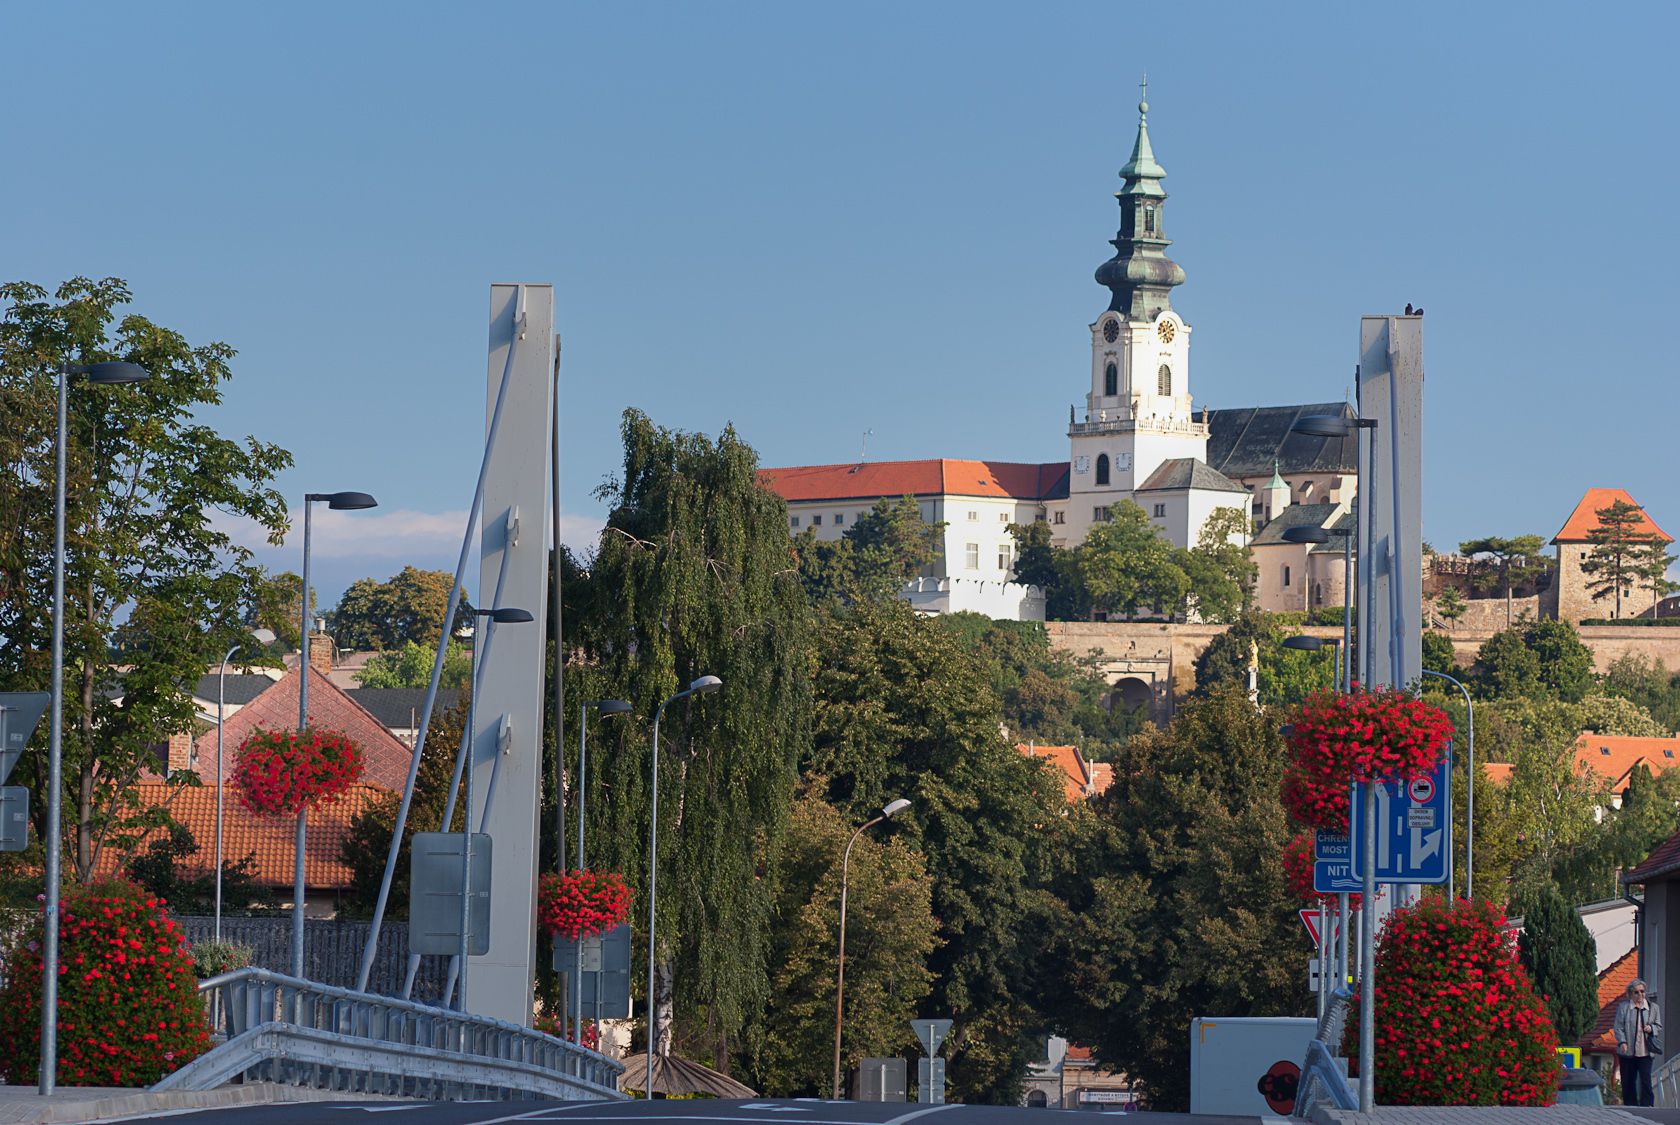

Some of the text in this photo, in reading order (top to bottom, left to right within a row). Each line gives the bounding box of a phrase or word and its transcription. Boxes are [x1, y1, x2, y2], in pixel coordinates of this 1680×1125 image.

[1317, 834, 1348, 843] CHREN
[1322, 845, 1349, 854] MOST
[1327, 865, 1349, 877] NIT
